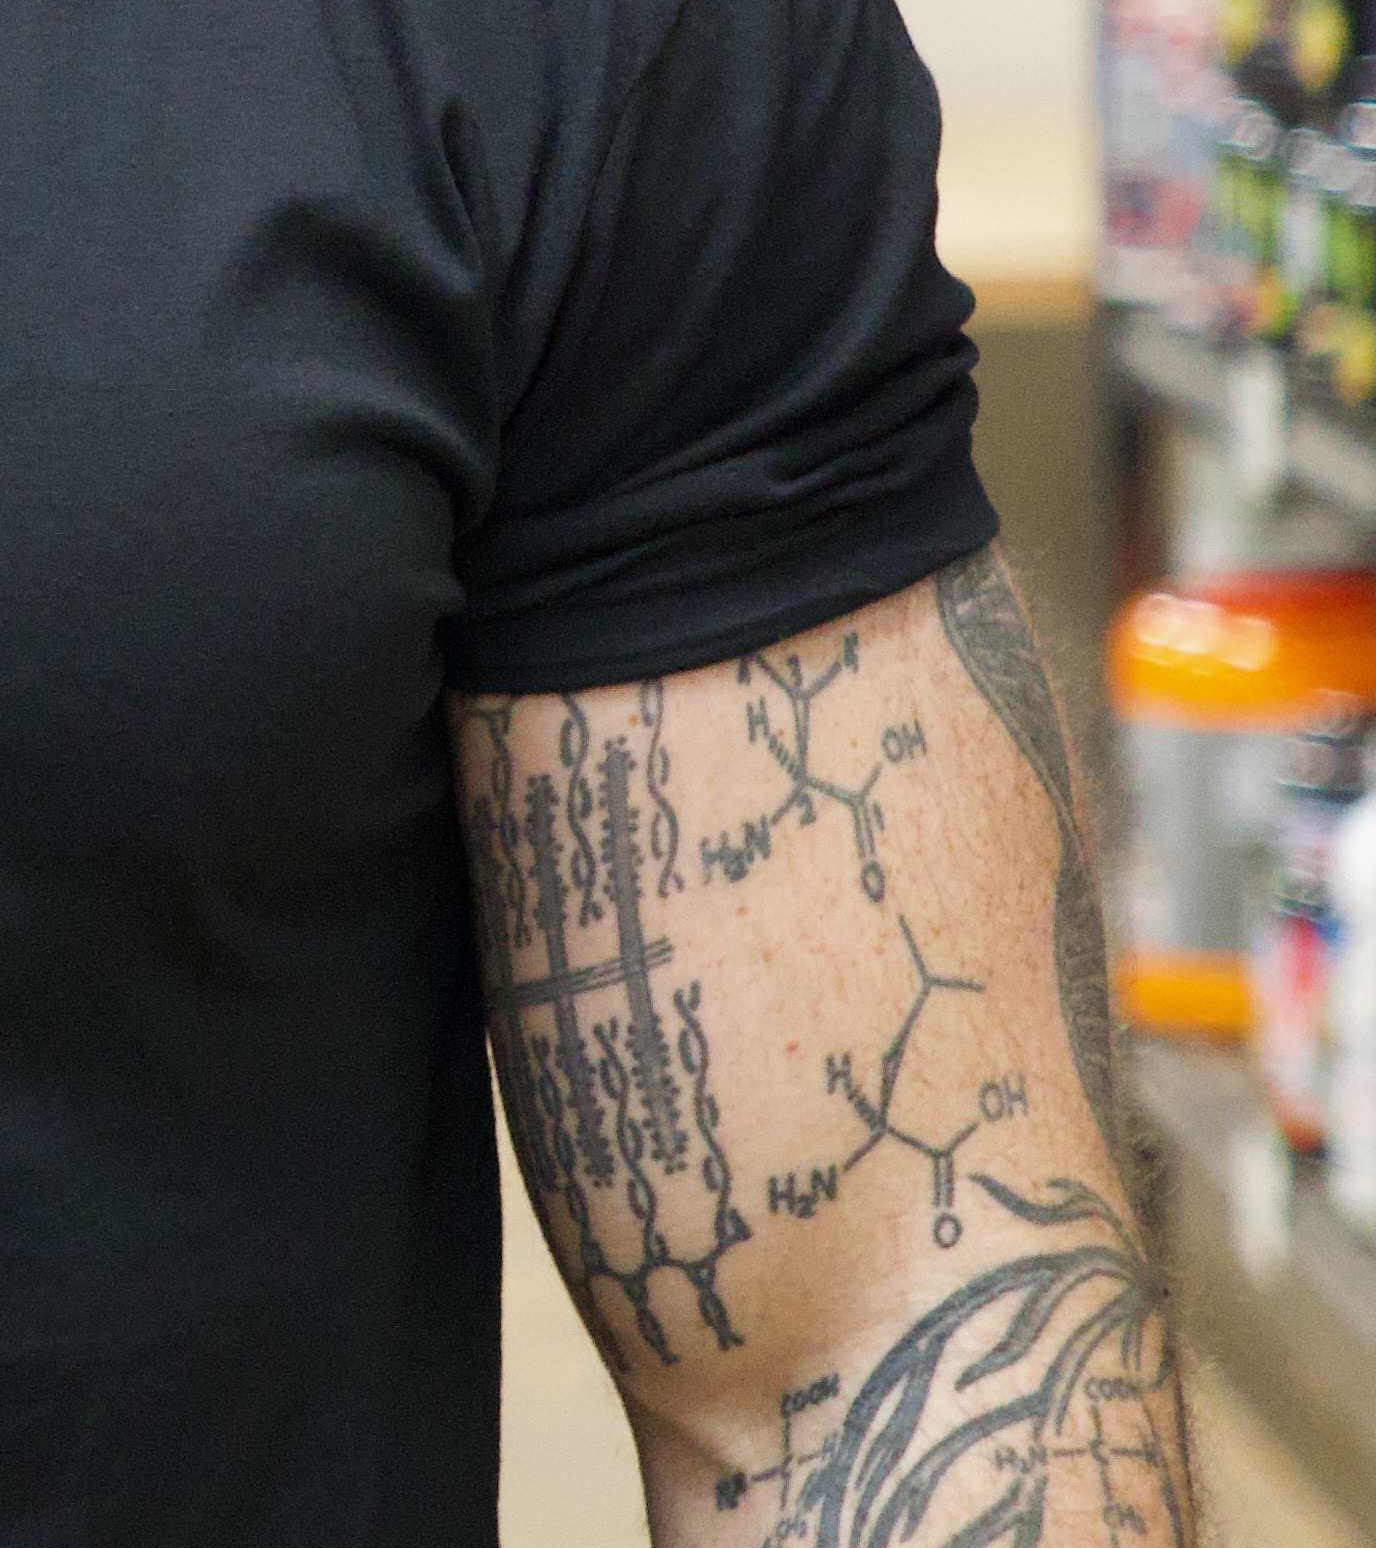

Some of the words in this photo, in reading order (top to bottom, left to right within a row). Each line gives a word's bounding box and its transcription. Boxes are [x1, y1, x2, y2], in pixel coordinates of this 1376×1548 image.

[881, 720, 927, 764] OH
[860, 860, 885, 903] O
[978, 1071, 1029, 1123] OH
[933, 1212, 962, 1249] O
